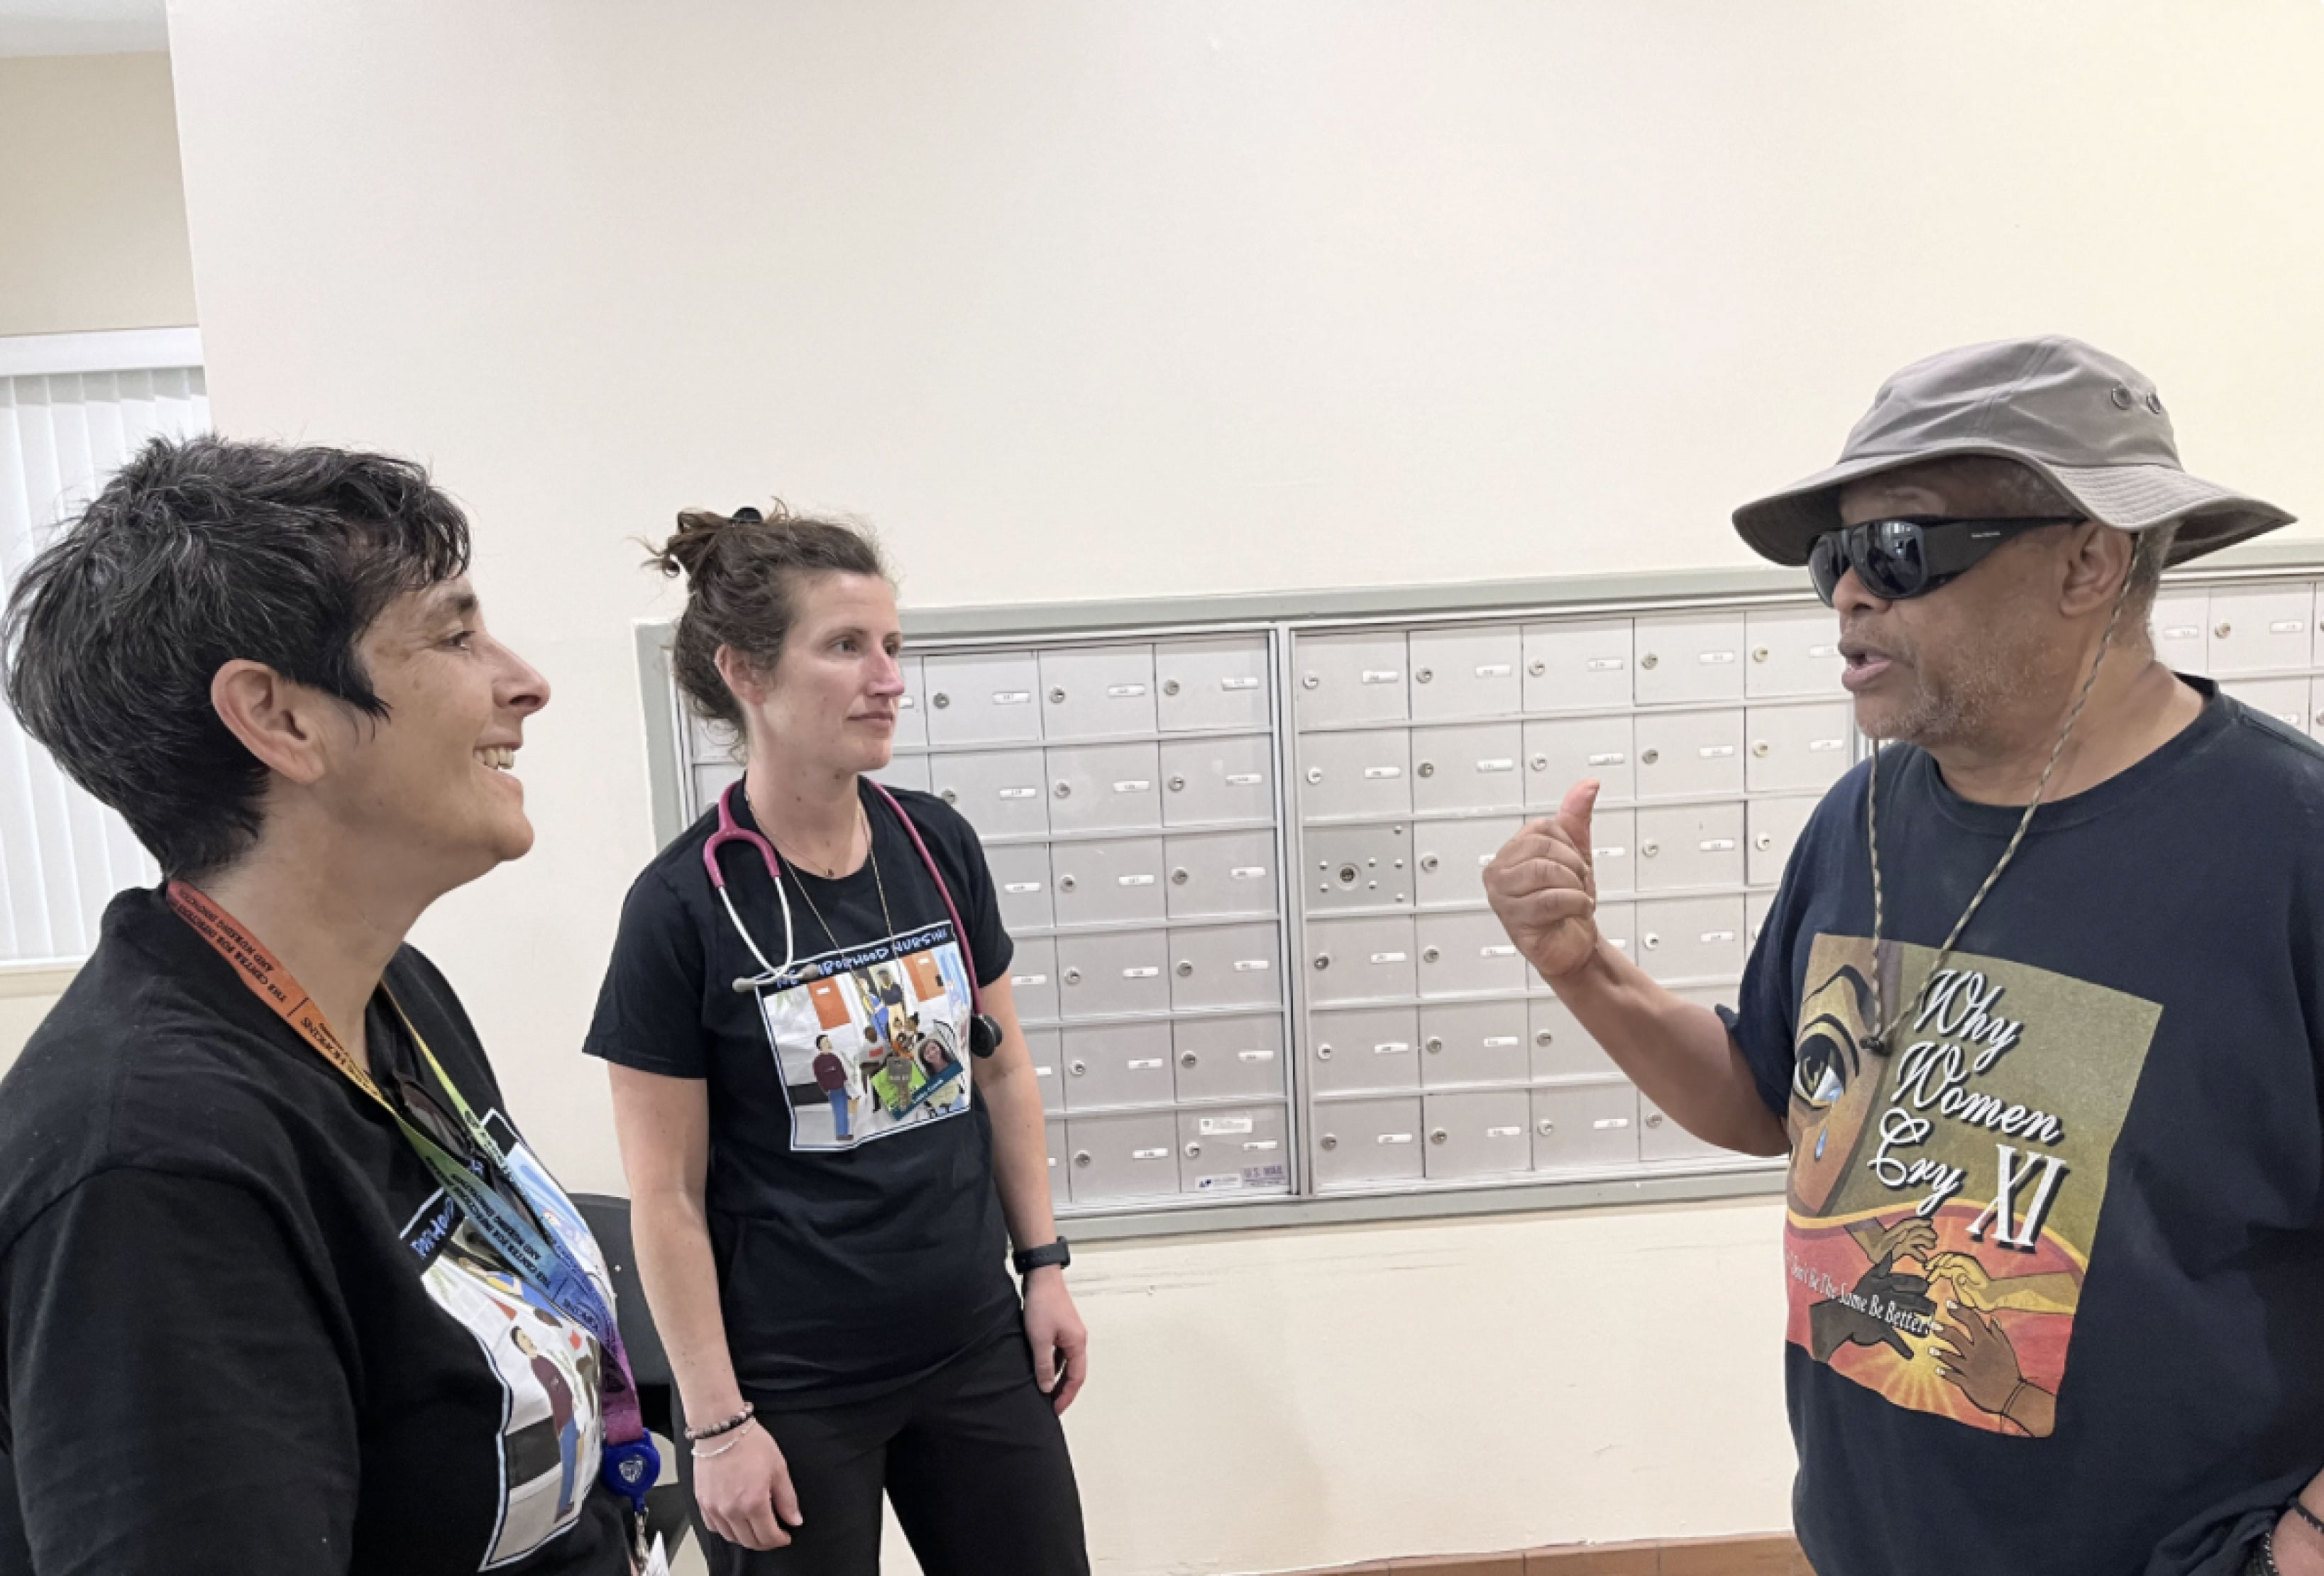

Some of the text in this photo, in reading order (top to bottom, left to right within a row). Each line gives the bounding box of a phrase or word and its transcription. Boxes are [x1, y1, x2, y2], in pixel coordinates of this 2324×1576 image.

[216, 935, 236, 954] FOR
[233, 950, 269, 985] CENTER
[253, 952, 274, 973] AND
[267, 983, 287, 1003] THE
[1913, 968, 2025, 1074] Why
[1890, 1040, 2061, 1145] Women
[1866, 1107, 1965, 1216] Cry
[1965, 1142, 2069, 1247] XI
[492, 1229, 510, 1247] FOR
[523, 1243, 541, 1260] AND
[507, 1244, 538, 1274] CENTER
[534, 1270, 551, 1289] THE
[1839, 1282, 1868, 1313] Same
[1868, 1294, 1884, 1319] Be
